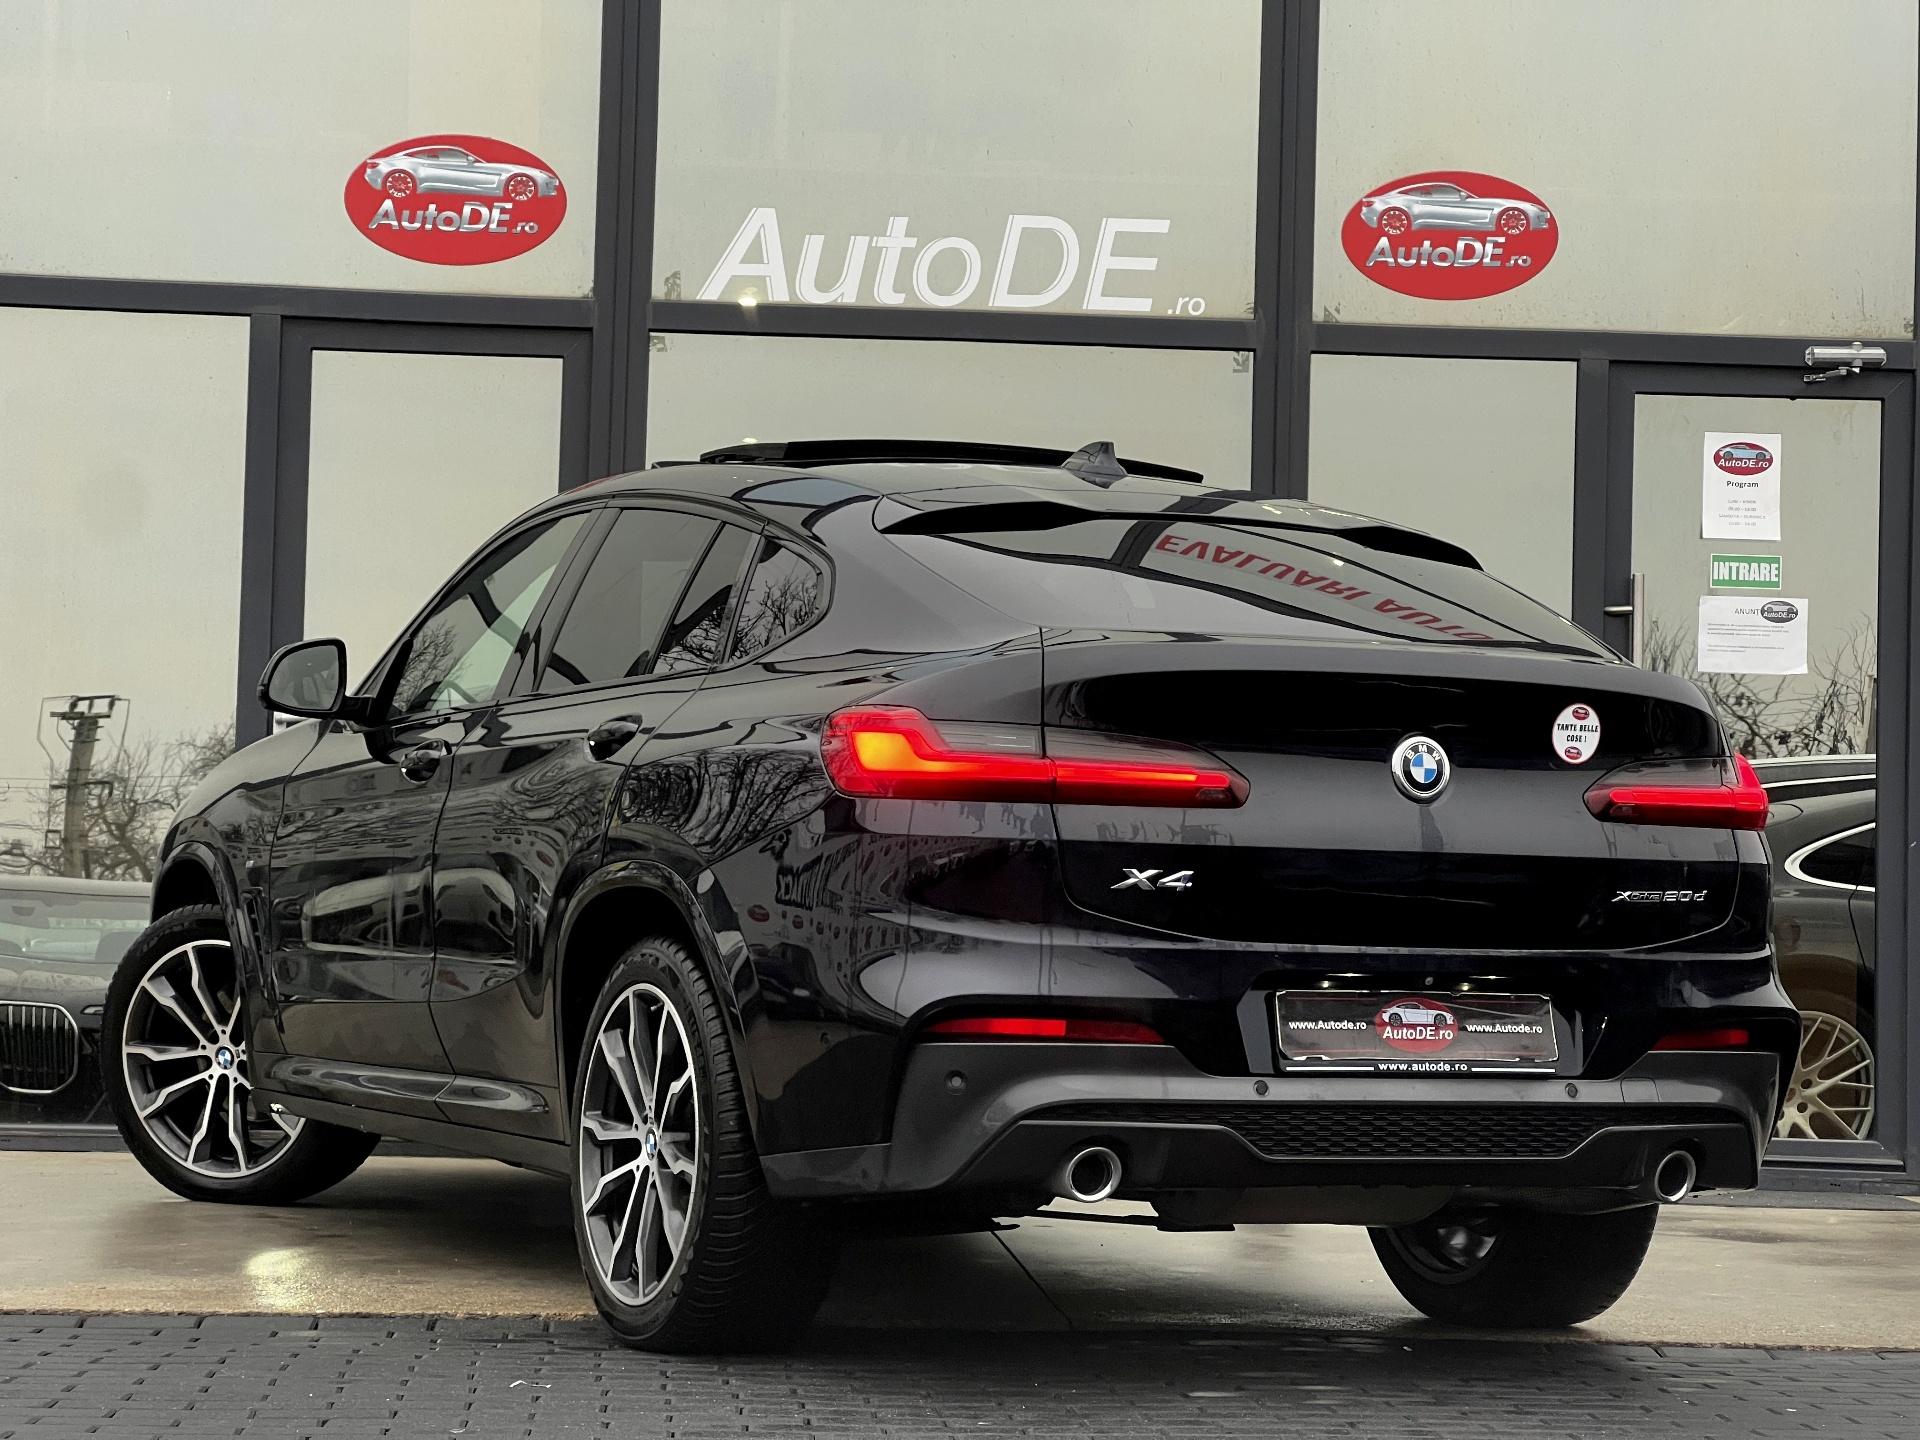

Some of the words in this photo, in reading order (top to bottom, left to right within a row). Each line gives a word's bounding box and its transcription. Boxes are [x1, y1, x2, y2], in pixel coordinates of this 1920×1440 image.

[1718, 459, 1769, 469] AutoDE.ro
[1726, 480, 1759, 489] Program
[1712, 561, 1779, 581] INTRARE
[1557, 723, 1577, 731] TANTE
[1579, 724, 1599, 732] BELLE
[1566, 734, 1582, 743] COSE
[1406, 744, 1441, 761] BMW
[1110, 868, 1195, 892] X4
[1288, 1019, 1367, 1031] www.Autode.ro
[1383, 1026, 1454, 1041] AutoDE.ro
[1466, 1023, 1543, 1035] www.Autode.ro
[1378, 1061, 1468, 1073] www.autode.ro
